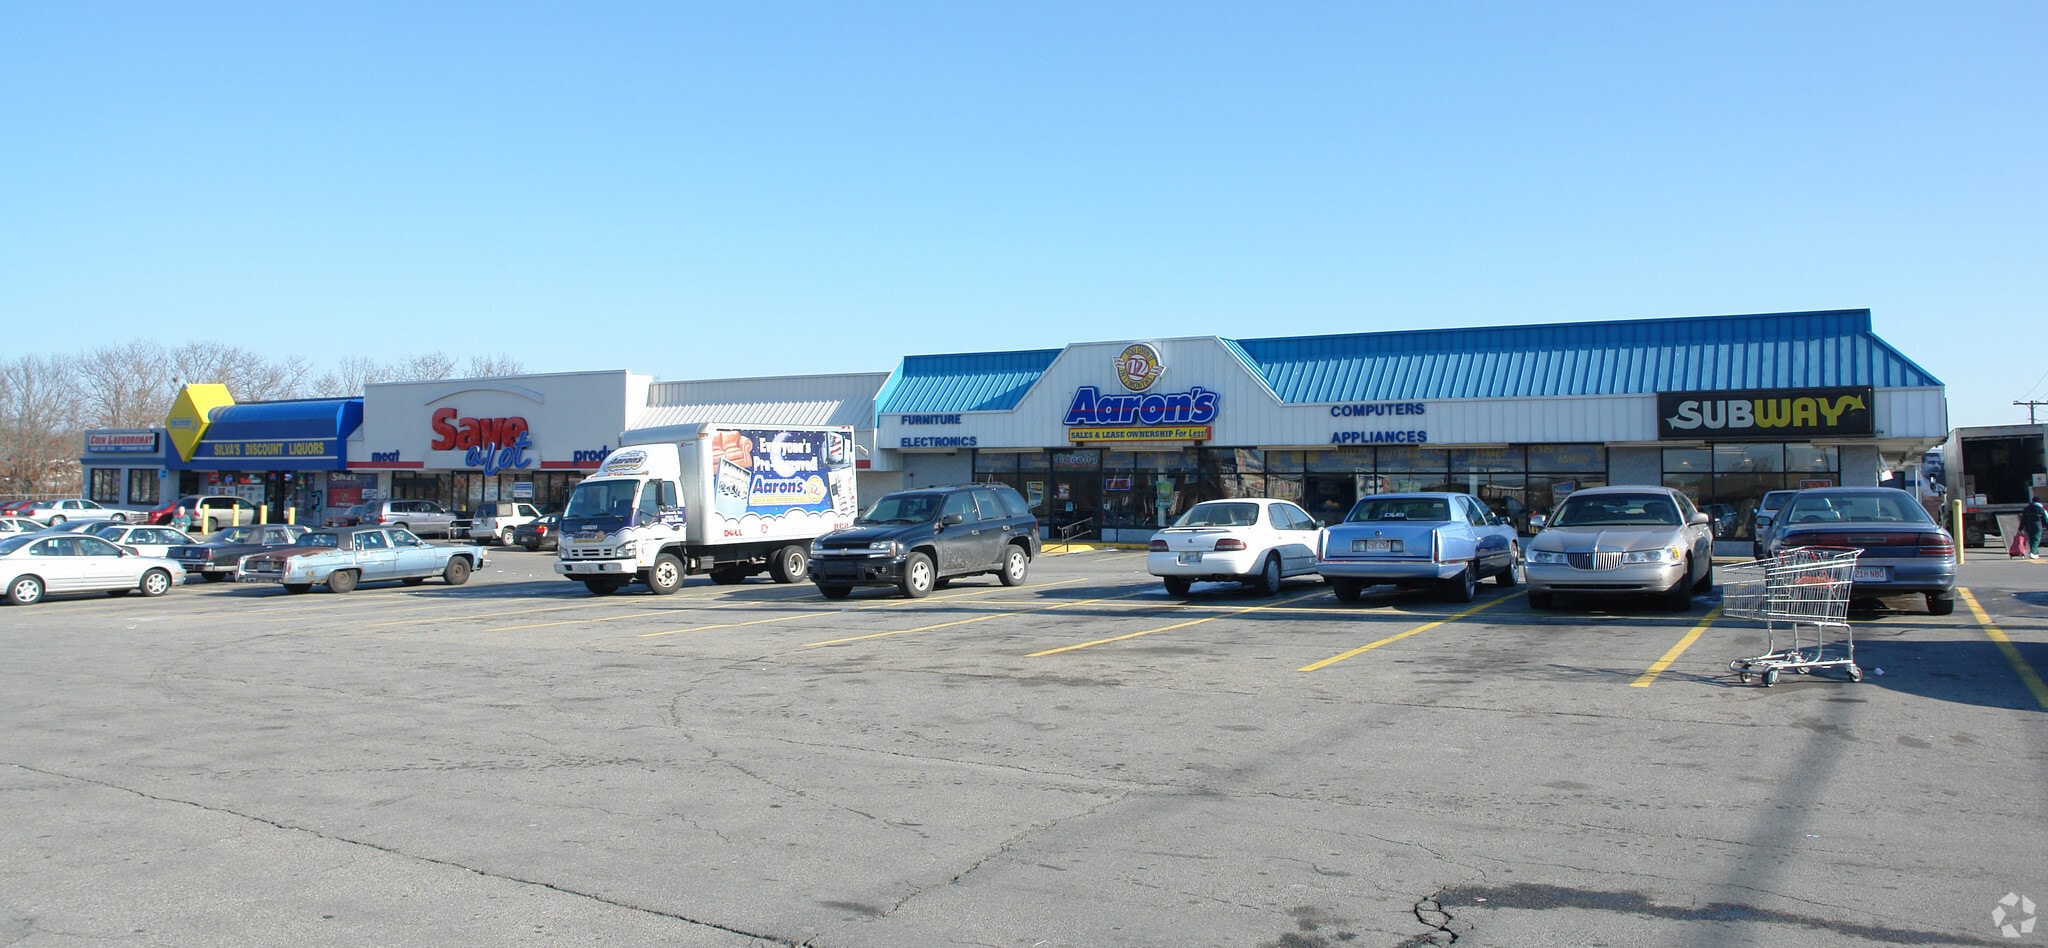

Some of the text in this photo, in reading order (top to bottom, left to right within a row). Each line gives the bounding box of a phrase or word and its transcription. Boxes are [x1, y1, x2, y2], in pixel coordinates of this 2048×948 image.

[1126, 358, 1148, 377] 12
[1064, 386, 1219, 425] Aaron's
[1330, 402, 1425, 417] COMPUTERS
[1666, 394, 1866, 430] SUBWAY
[901, 413, 962, 425] FURNITURE
[431, 407, 529, 450] Save
[1071, 431, 1093, 439] SALES
[1102, 430, 1125, 438] LEASE
[1126, 430, 1173, 438] OWNERSHIP
[1175, 429, 1187, 437] For
[901, 436, 977, 447] ELECTRONICS
[1331, 430, 1427, 443] APPLIANCES
[214, 442, 324, 456] SILVA'S DISCOUNT LIQUORS
[371, 449, 400, 462] meat
[752, 478, 803, 494] Aaron's
[723, 529, 743, 537] DELL
